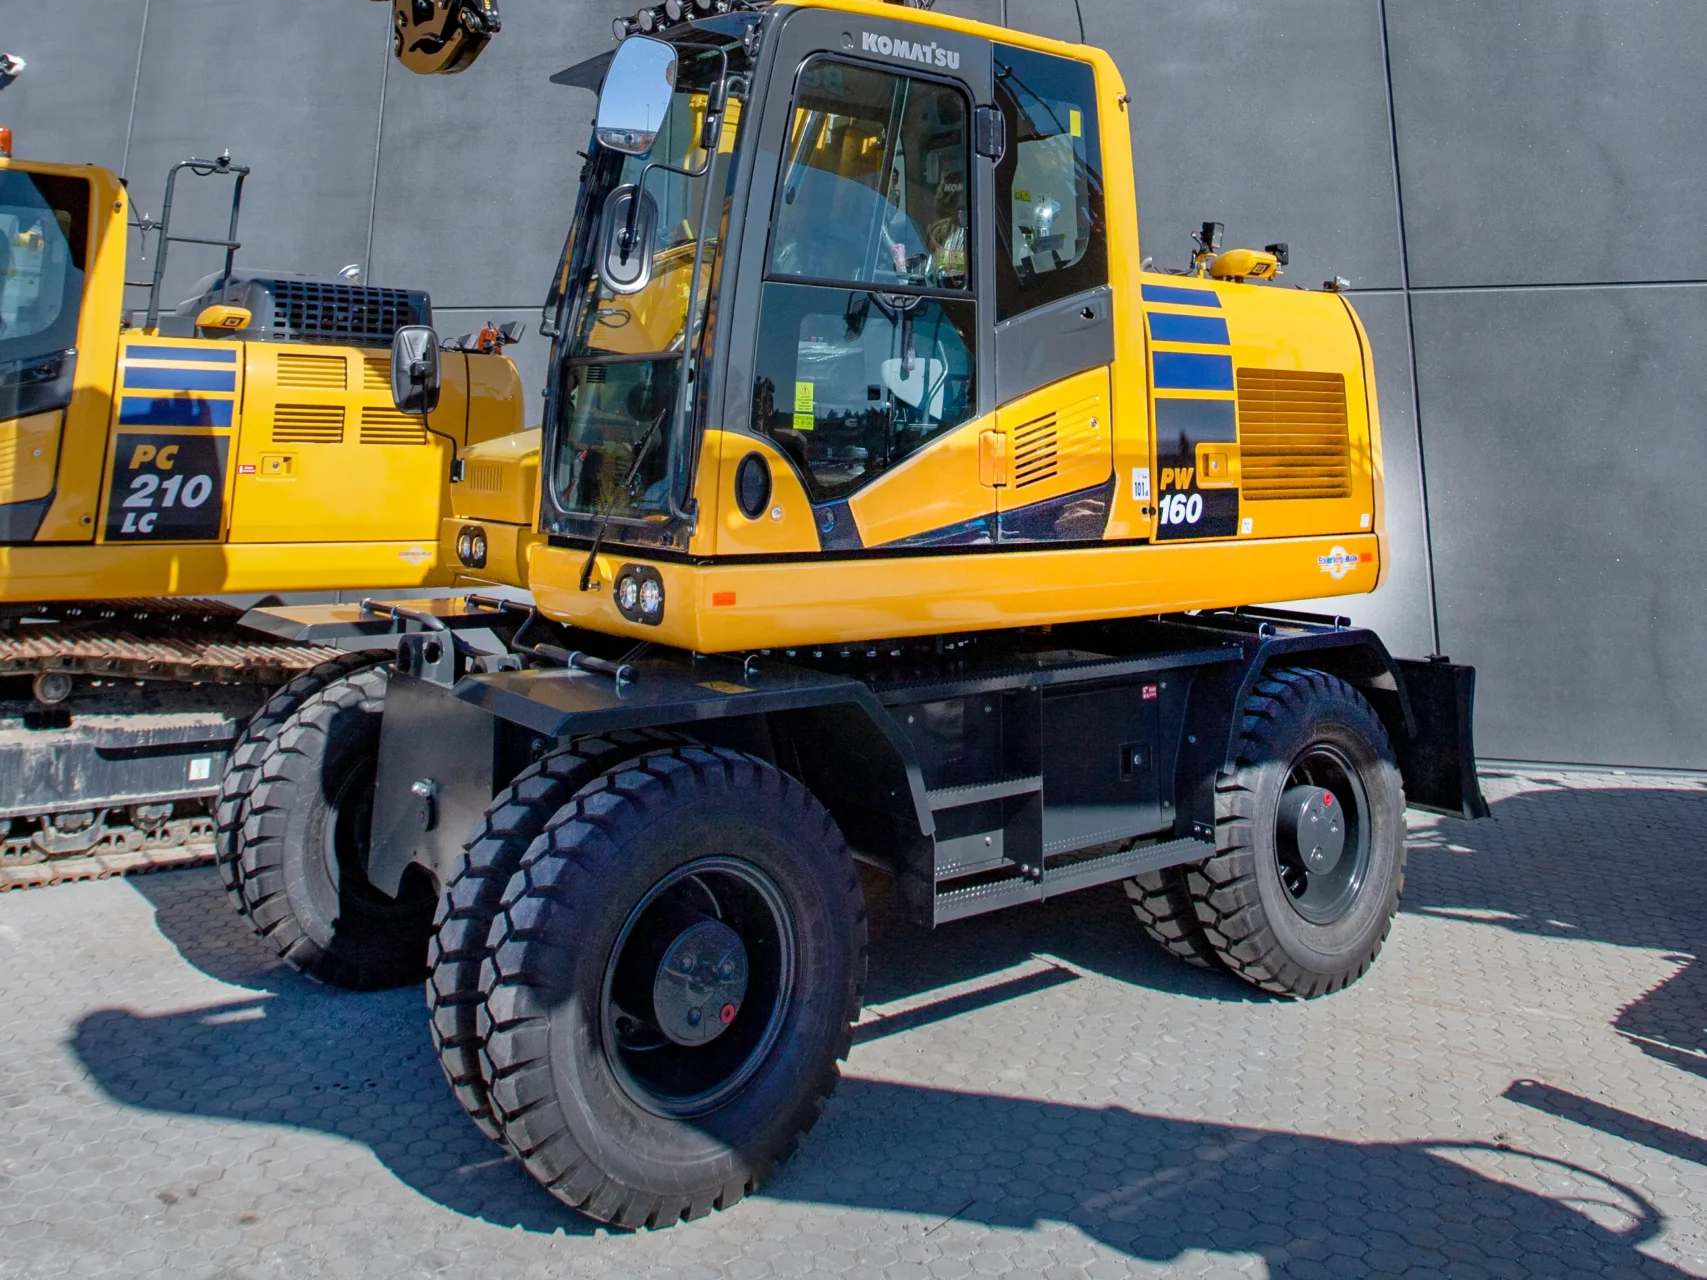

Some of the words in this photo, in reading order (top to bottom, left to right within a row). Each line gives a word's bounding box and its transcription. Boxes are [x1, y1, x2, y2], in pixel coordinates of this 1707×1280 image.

[862, 31, 960, 70] KOMATSU
[128, 444, 180, 470] PC
[121, 473, 213, 508] 210
[1160, 467, 1195, 490] PW
[120, 512, 159, 533] LC
[1159, 493, 1203, 525] 160
